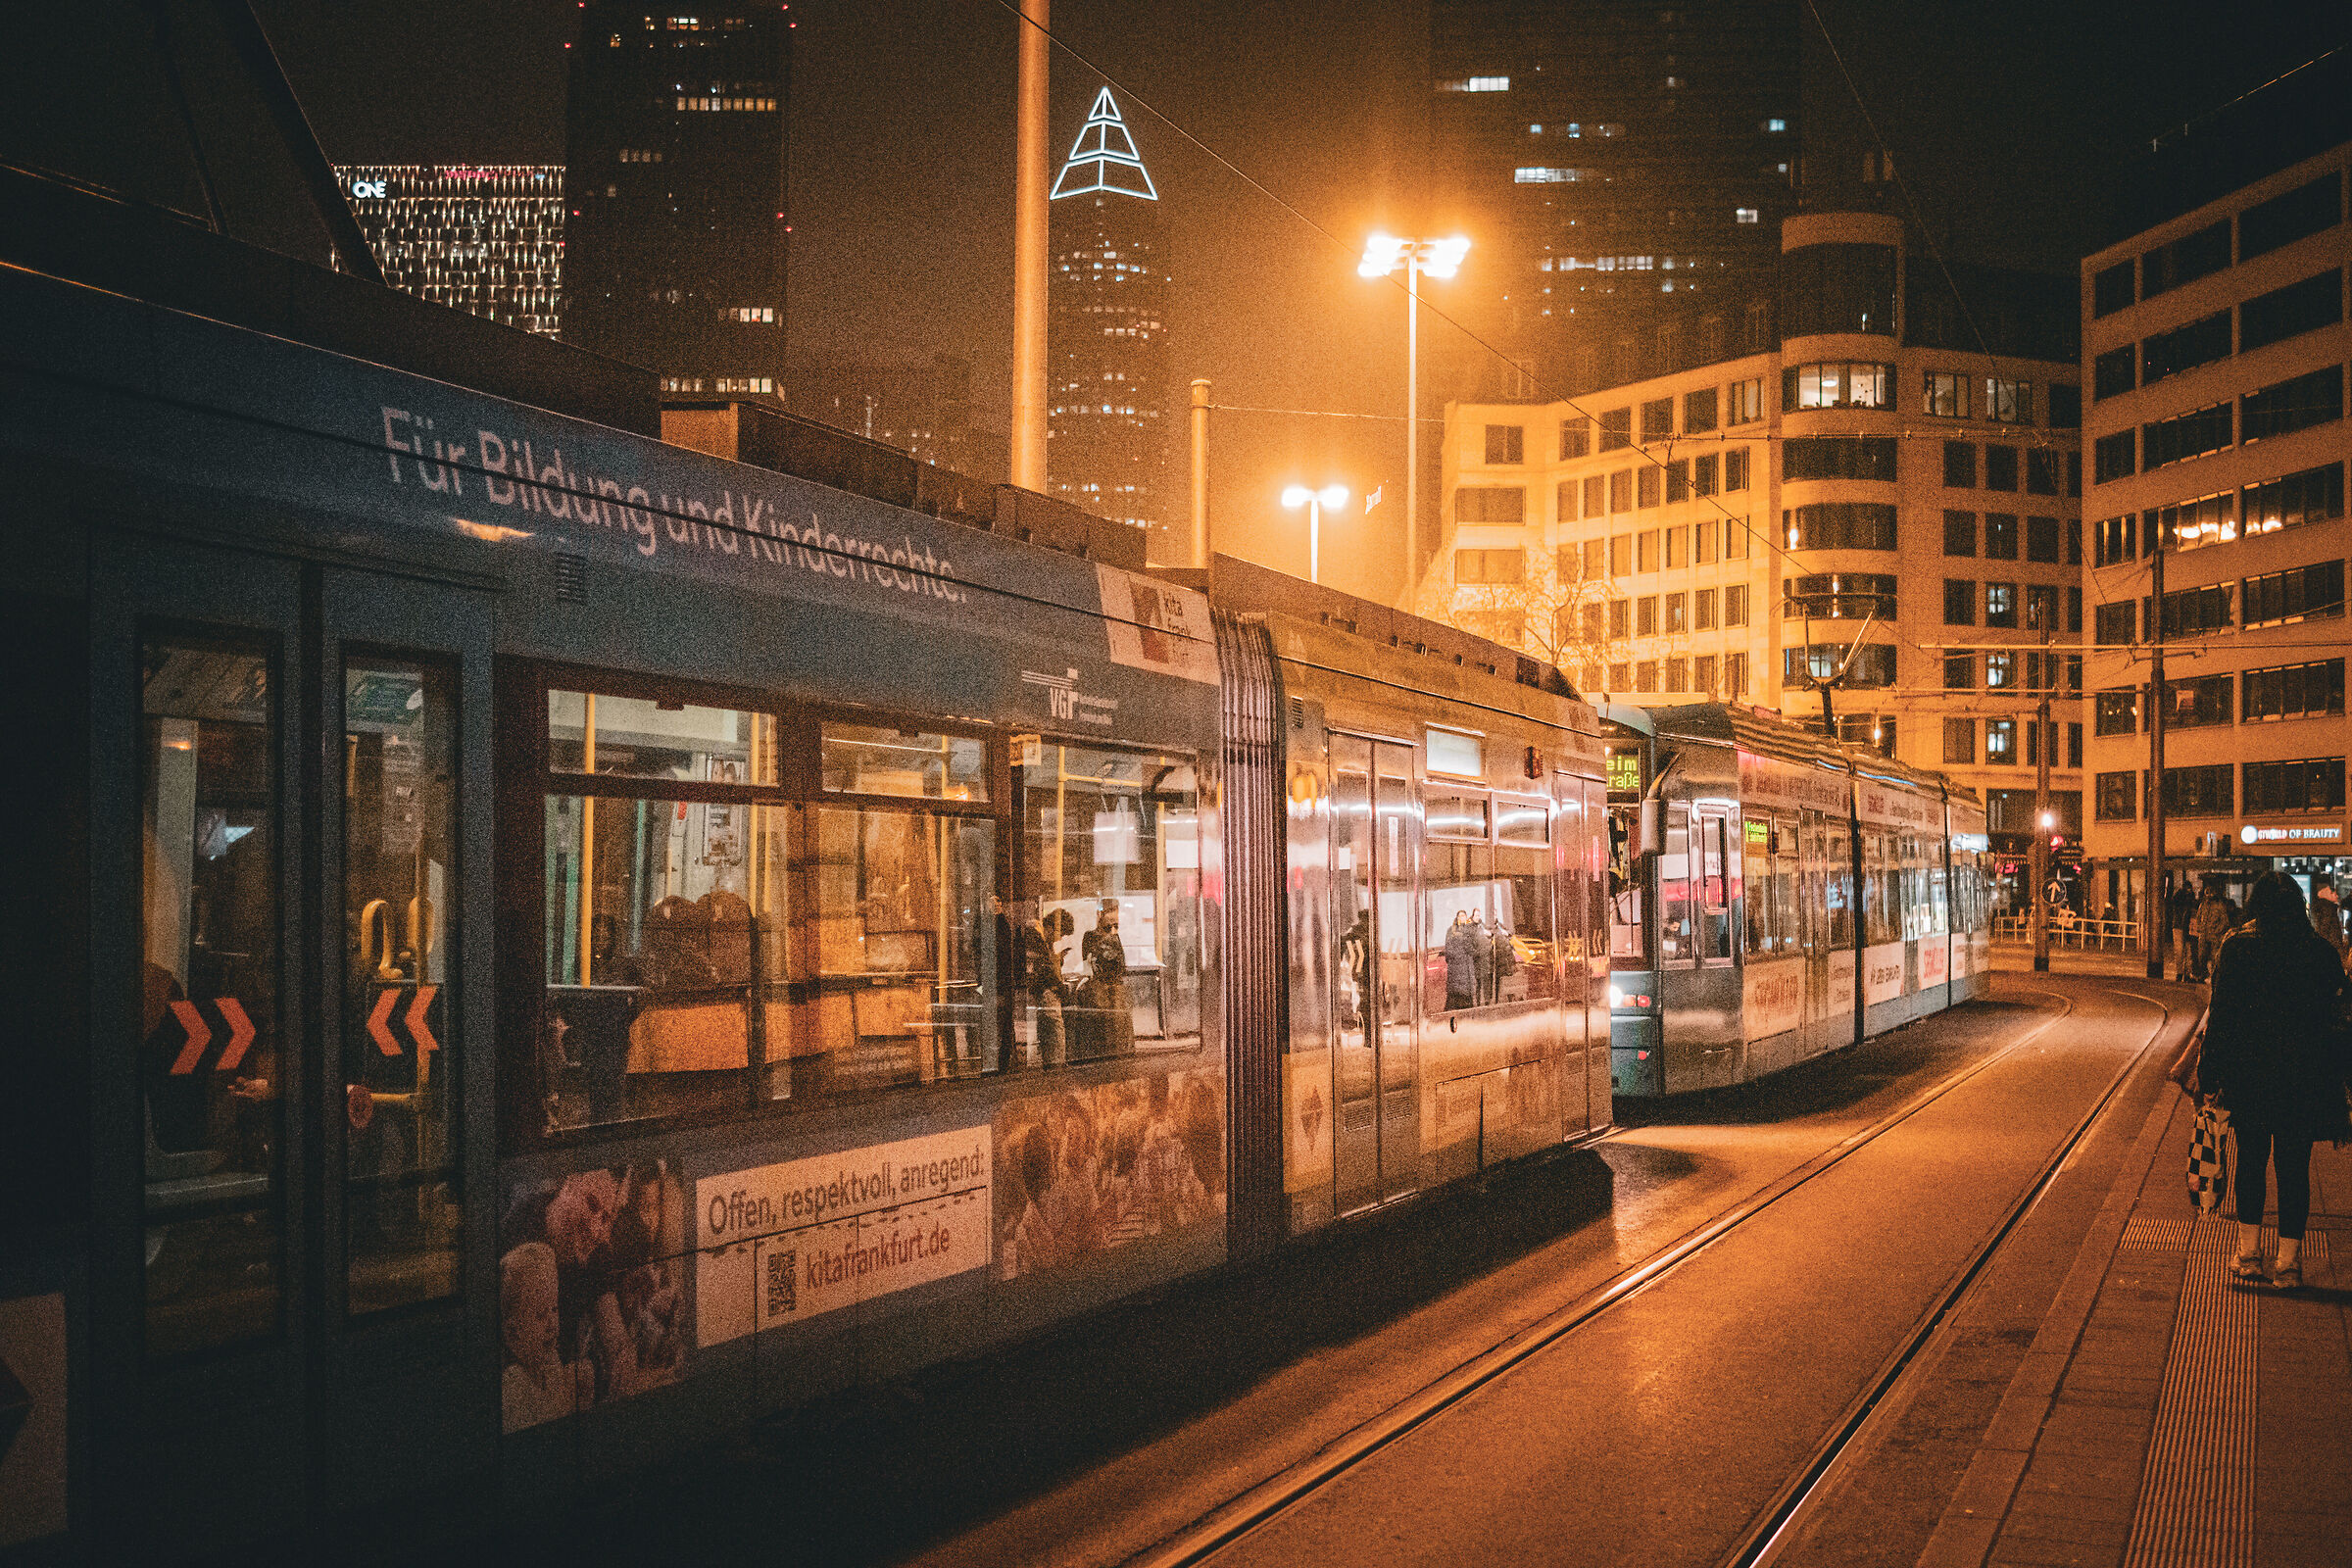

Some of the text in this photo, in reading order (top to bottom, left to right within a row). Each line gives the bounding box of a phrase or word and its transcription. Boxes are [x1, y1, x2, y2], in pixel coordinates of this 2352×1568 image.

[353, 180, 386, 199] ONE
[380, 405, 967, 604] Für Bildung und Kinderrechte.
[1606, 771, 1641, 790] raße
[2288, 829, 2301, 839] OF
[2303, 828, 2339, 839] BEAUTY
[708, 1189, 777, 1235] Offen,
[783, 1163, 897, 1221] respektvoll,
[806, 1221, 951, 1290] kitafrankfurt.de
